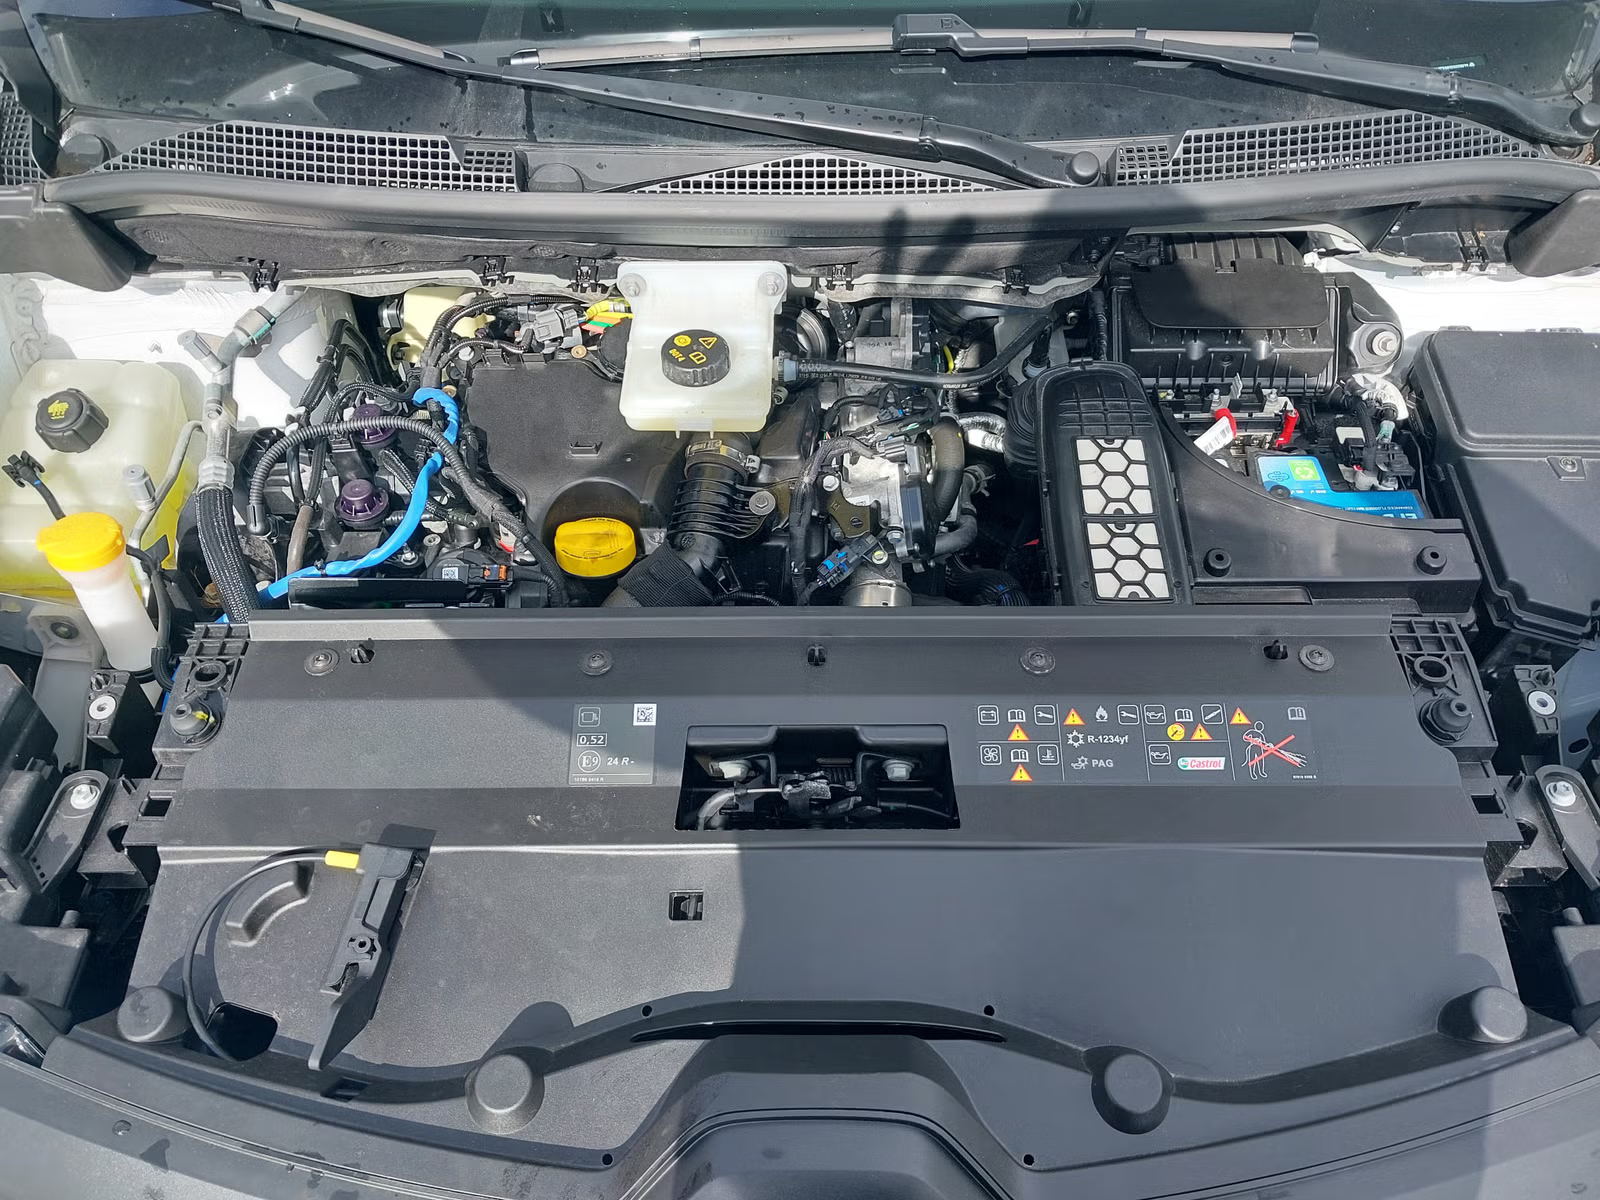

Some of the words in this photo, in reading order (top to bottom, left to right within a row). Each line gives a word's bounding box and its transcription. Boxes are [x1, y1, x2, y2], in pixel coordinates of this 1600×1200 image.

[579, 735, 604, 745] 0,52
[1087, 735, 1129, 745] R-1234yf
[581, 755, 599, 768] E9
[606, 757, 619, 766] 24
[1092, 759, 1114, 768] PAG
[1189, 758, 1222, 769] Castrol
